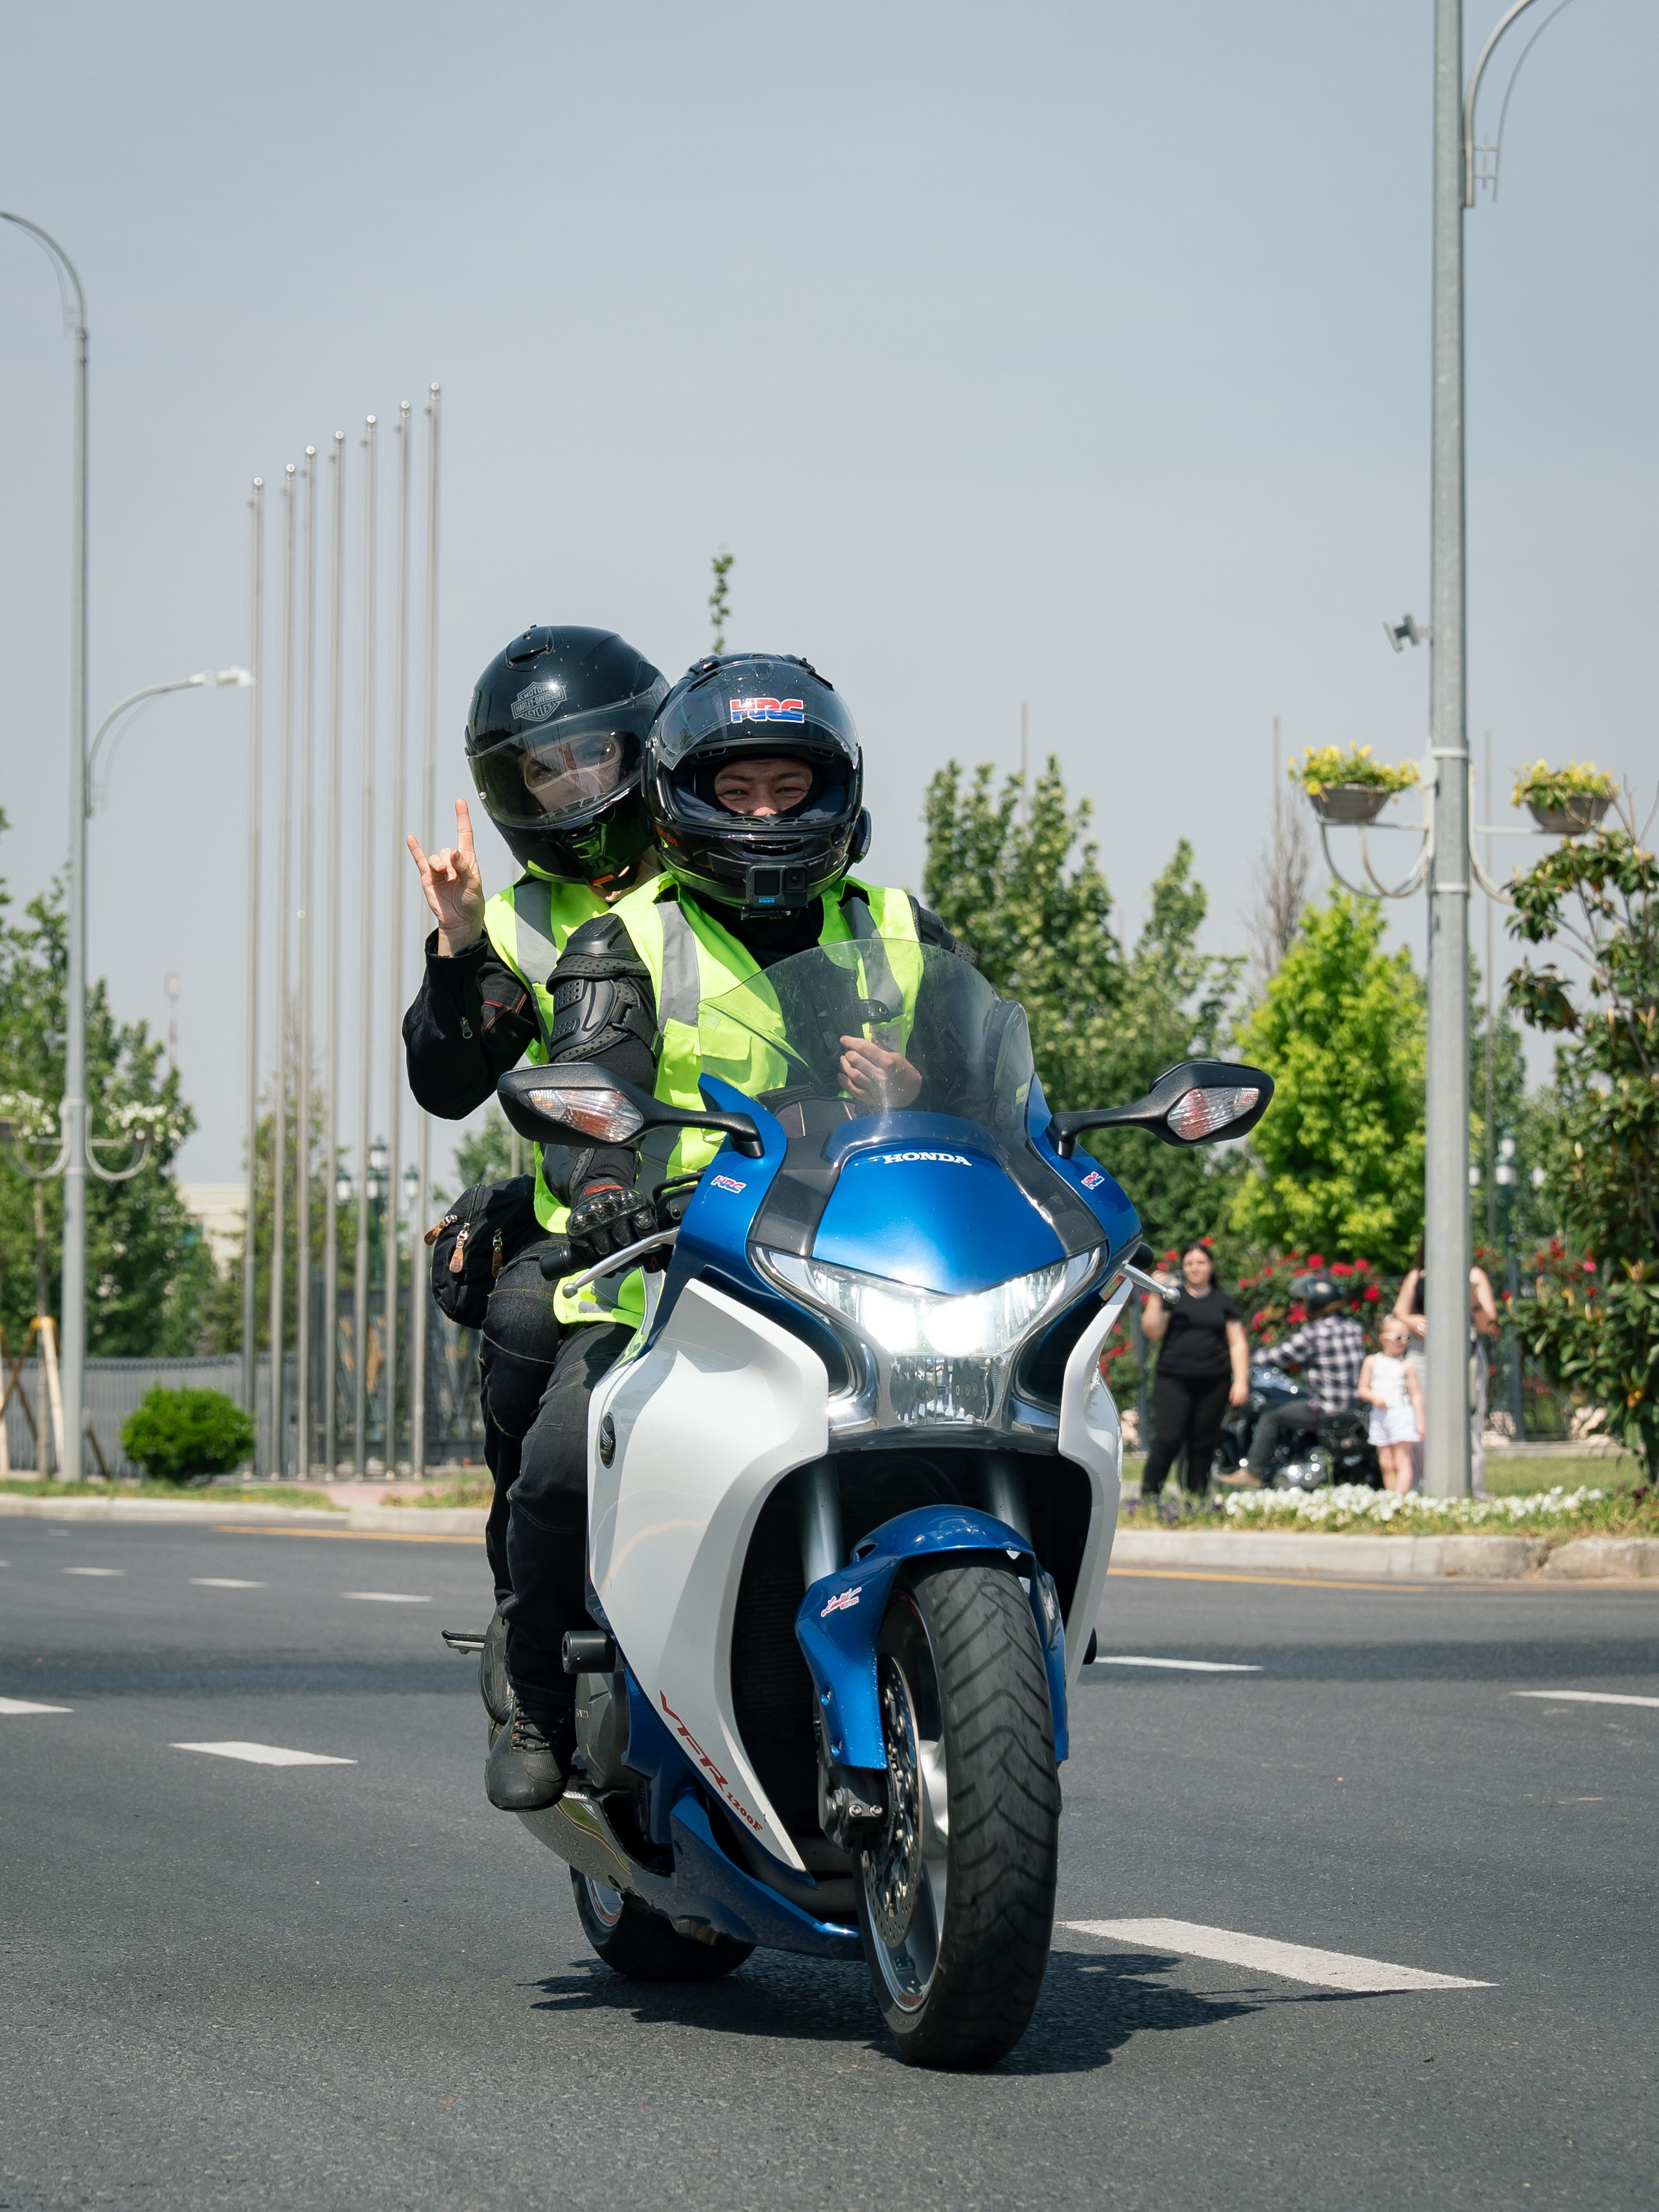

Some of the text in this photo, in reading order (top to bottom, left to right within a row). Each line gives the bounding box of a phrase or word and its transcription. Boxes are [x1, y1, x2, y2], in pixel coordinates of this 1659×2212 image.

[516, 690, 561, 713] HARLEY-DAVIDSON
[524, 686, 548, 699] MOTOR
[528, 703, 552, 717] CYCLES
[729, 697, 804, 724] HRC
[883, 1152, 972, 1166] HONDA
[710, 1174, 747, 1194] HRC
[660, 1690, 763, 1831] VFR 1200F
